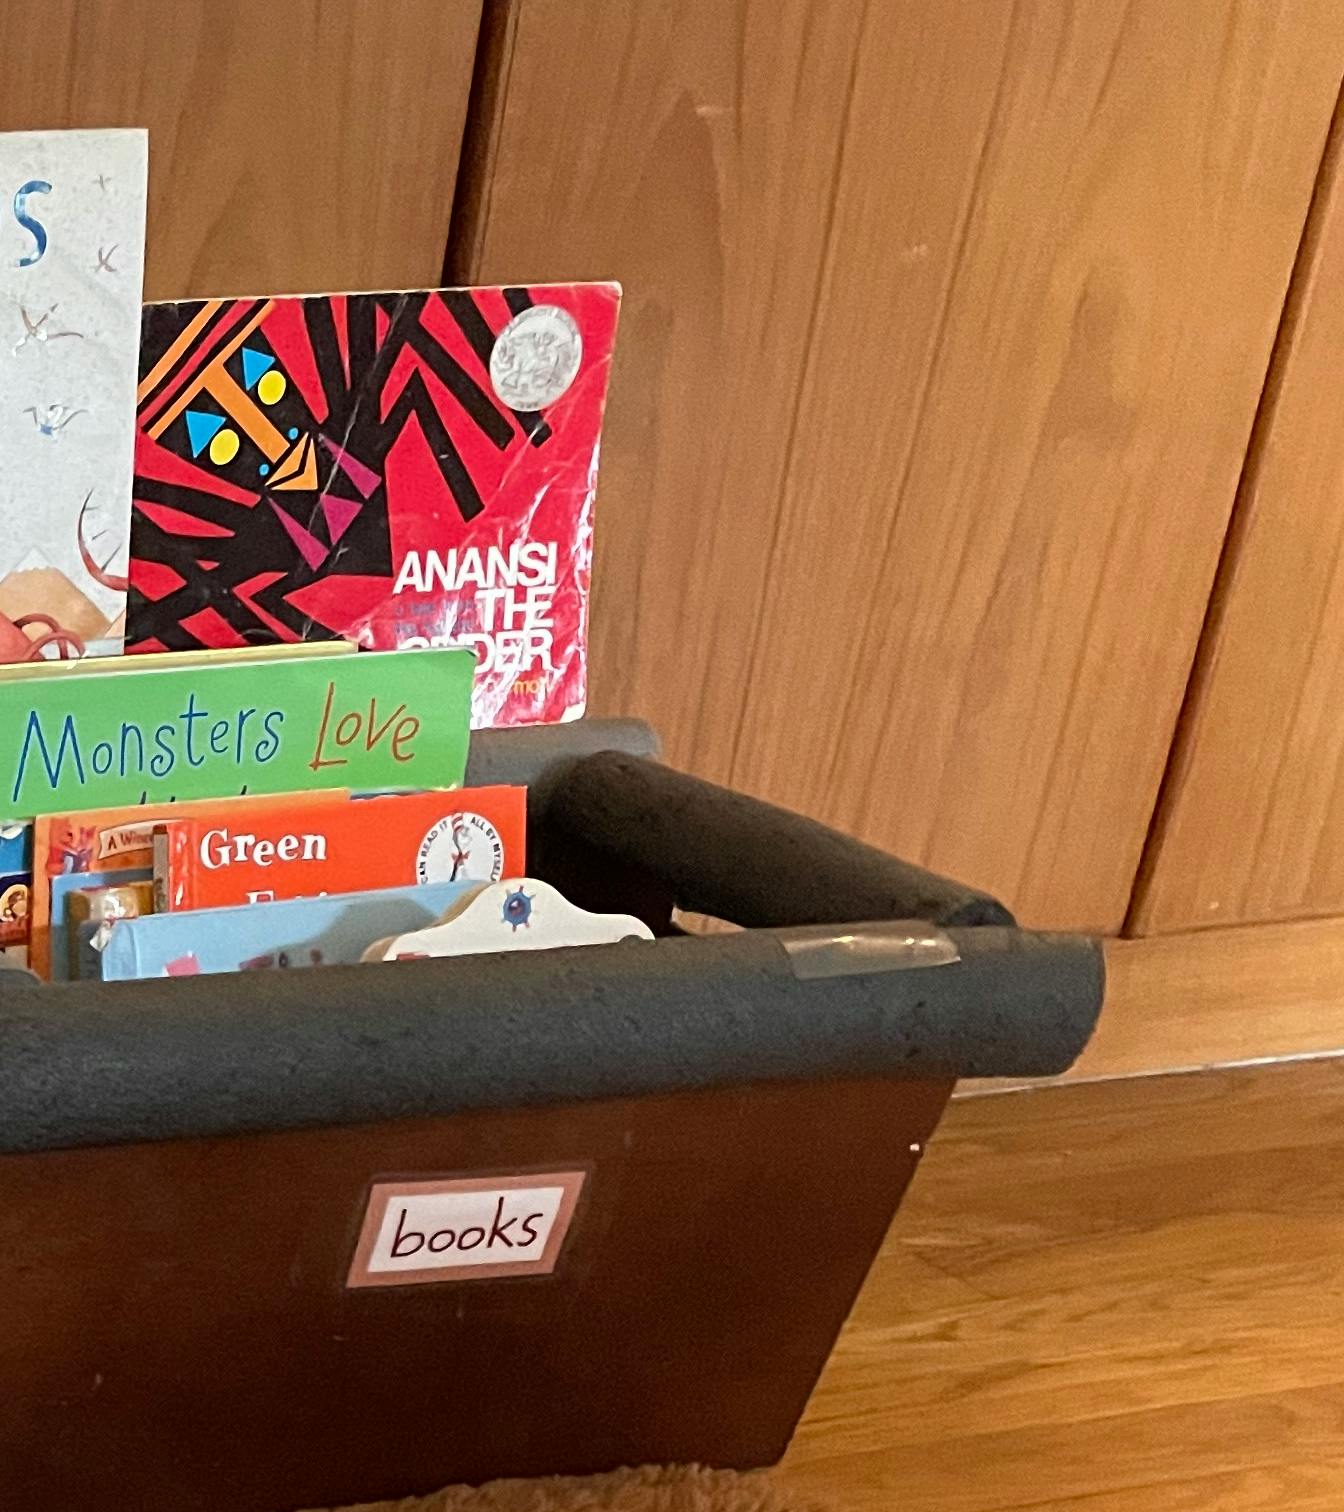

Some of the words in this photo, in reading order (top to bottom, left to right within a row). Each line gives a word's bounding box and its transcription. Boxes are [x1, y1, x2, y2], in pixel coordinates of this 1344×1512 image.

[392, 541, 558, 595] ANANSI
[474, 586, 558, 632] THE
[13, 693, 284, 801] Monsters
[310, 681, 419, 771] Love
[199, 828, 327, 870] Green
[390, 1196, 544, 1258] books
